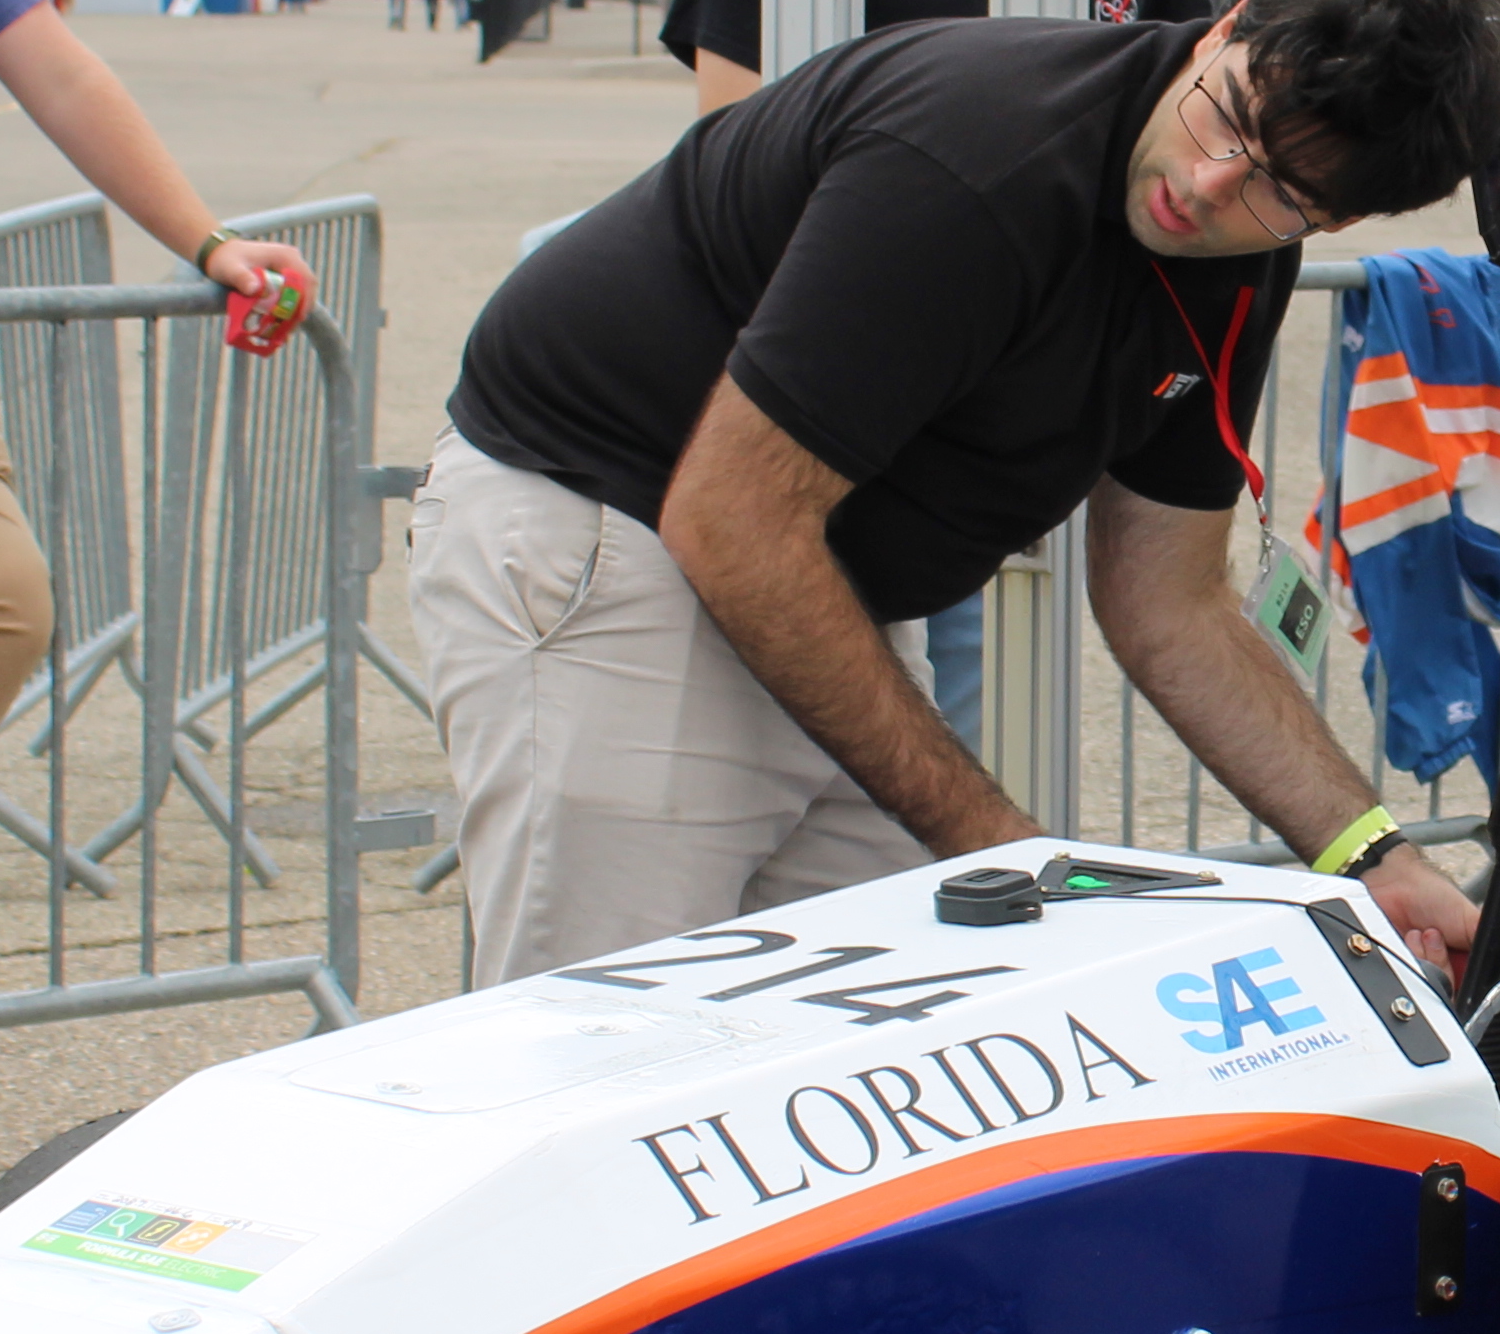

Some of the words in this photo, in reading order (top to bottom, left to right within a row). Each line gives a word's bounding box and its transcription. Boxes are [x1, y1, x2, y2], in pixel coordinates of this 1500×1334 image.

[1295, 604, 1314, 640] ESO
[546, 929, 1026, 1027] 214
[1155, 945, 1326, 1055] SAE
[1206, 1030, 1346, 1083] INTERNATIONAL
[633, 1011, 1158, 1227] FLORIDA
[76, 1241, 138, 1262] FORMULA
[135, 1250, 168, 1267] SAE
